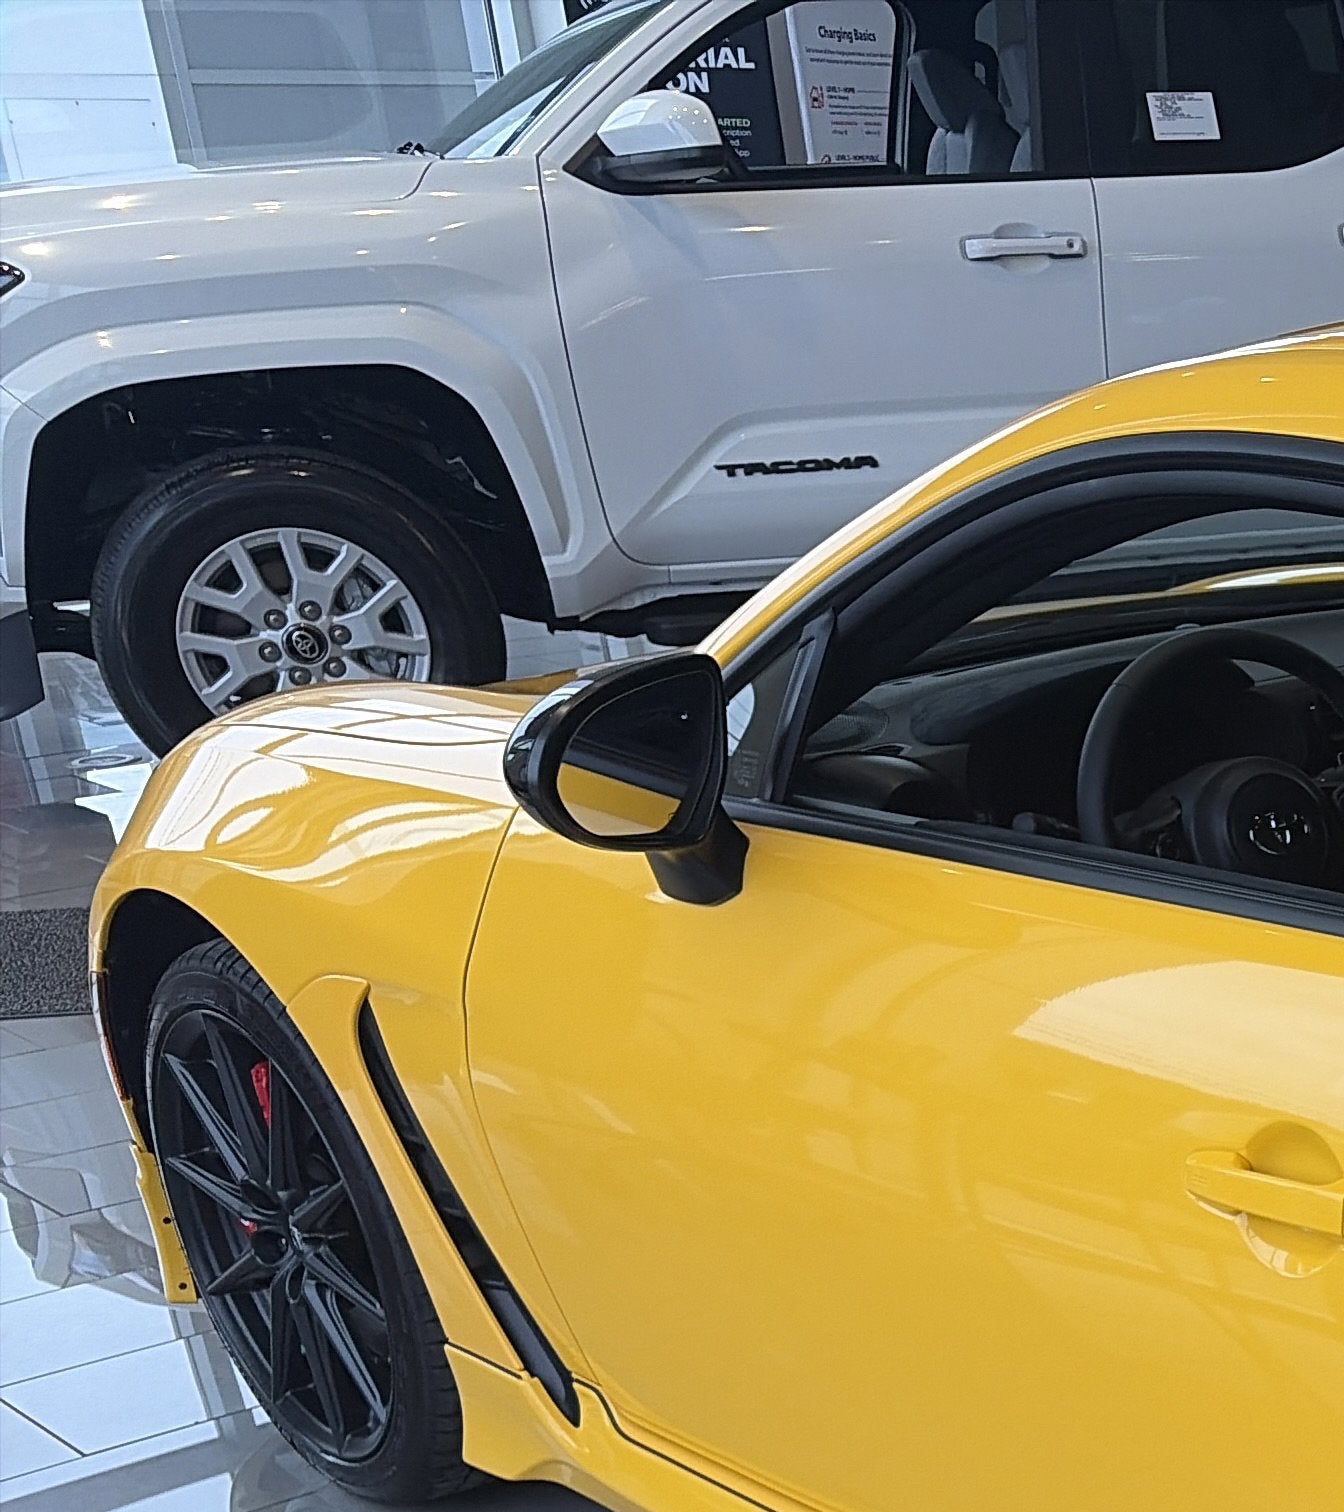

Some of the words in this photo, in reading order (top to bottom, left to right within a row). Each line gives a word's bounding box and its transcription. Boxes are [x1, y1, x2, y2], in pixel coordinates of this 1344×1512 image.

[818, 25, 853, 43] Charging
[853, 28, 877, 42] Basics
[688, 46, 756, 69] RIAL
[665, 71, 710, 93] ON
[718, 118, 751, 127] ARTED
[722, 129, 752, 138] cription
[713, 455, 880, 478] TACOMA
